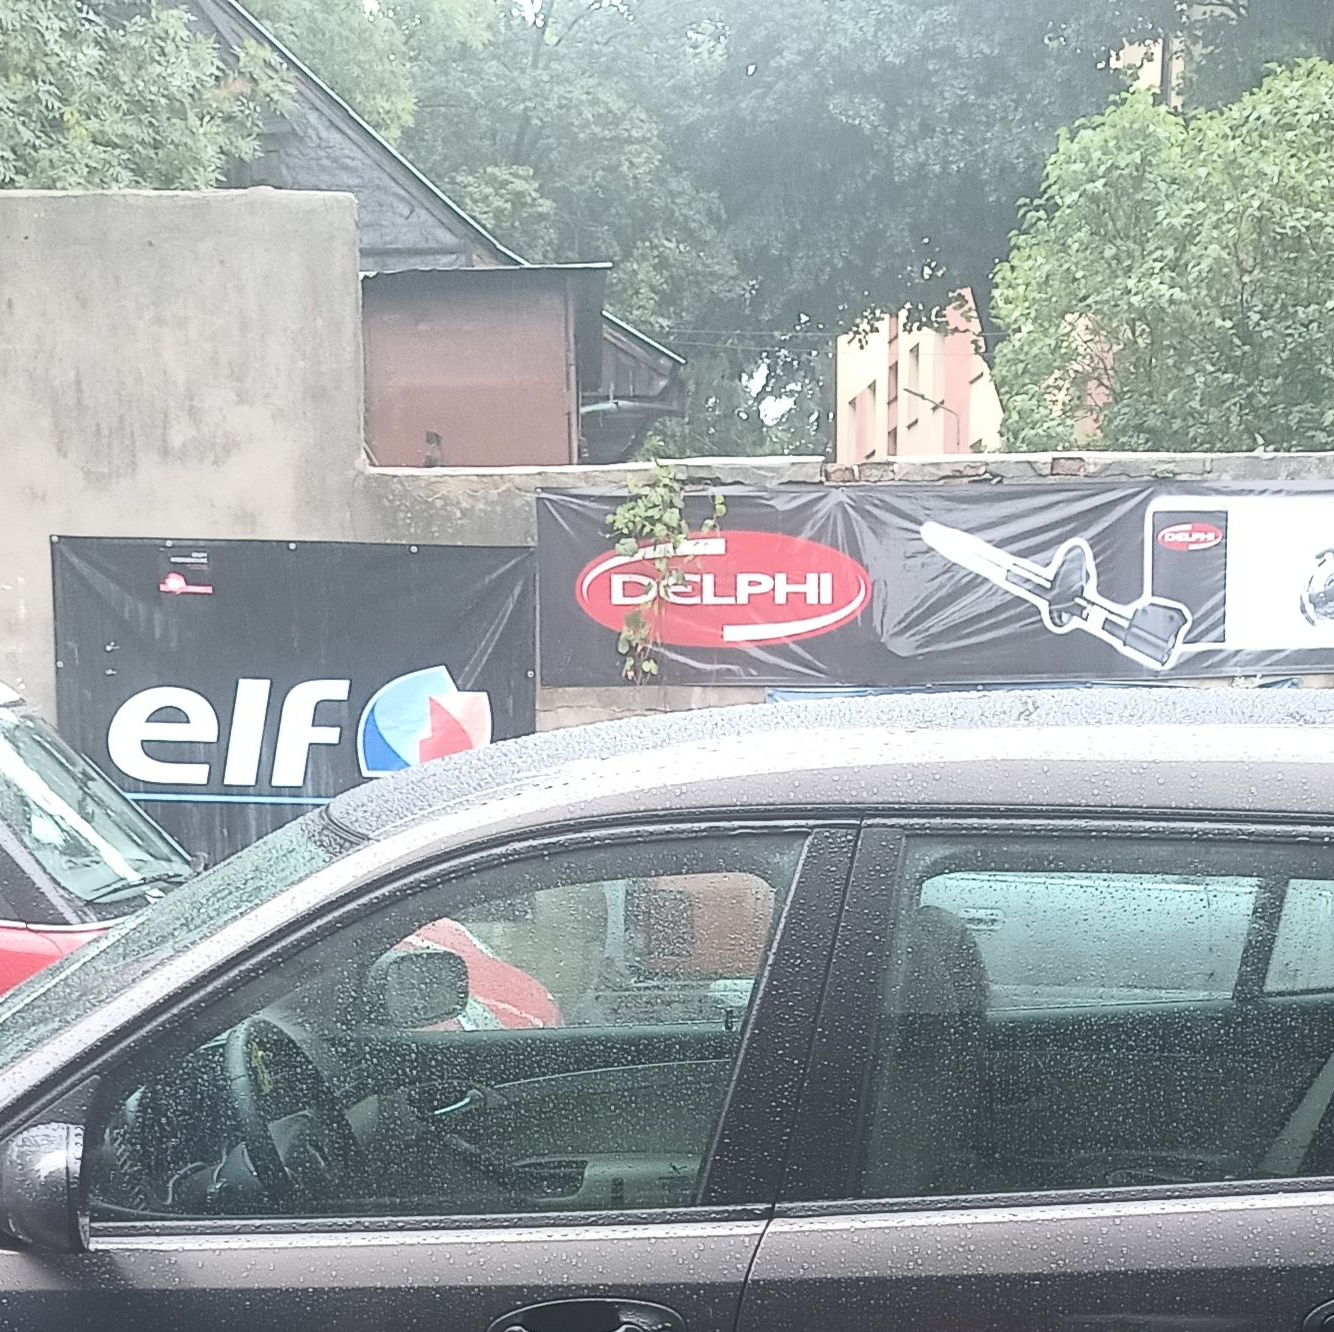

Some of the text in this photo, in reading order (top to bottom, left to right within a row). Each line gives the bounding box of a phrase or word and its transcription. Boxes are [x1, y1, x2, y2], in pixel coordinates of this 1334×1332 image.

[1164, 532, 1215, 542] DELPHI
[611, 572, 832, 605] DELPHI
[108, 678, 351, 786] elf
